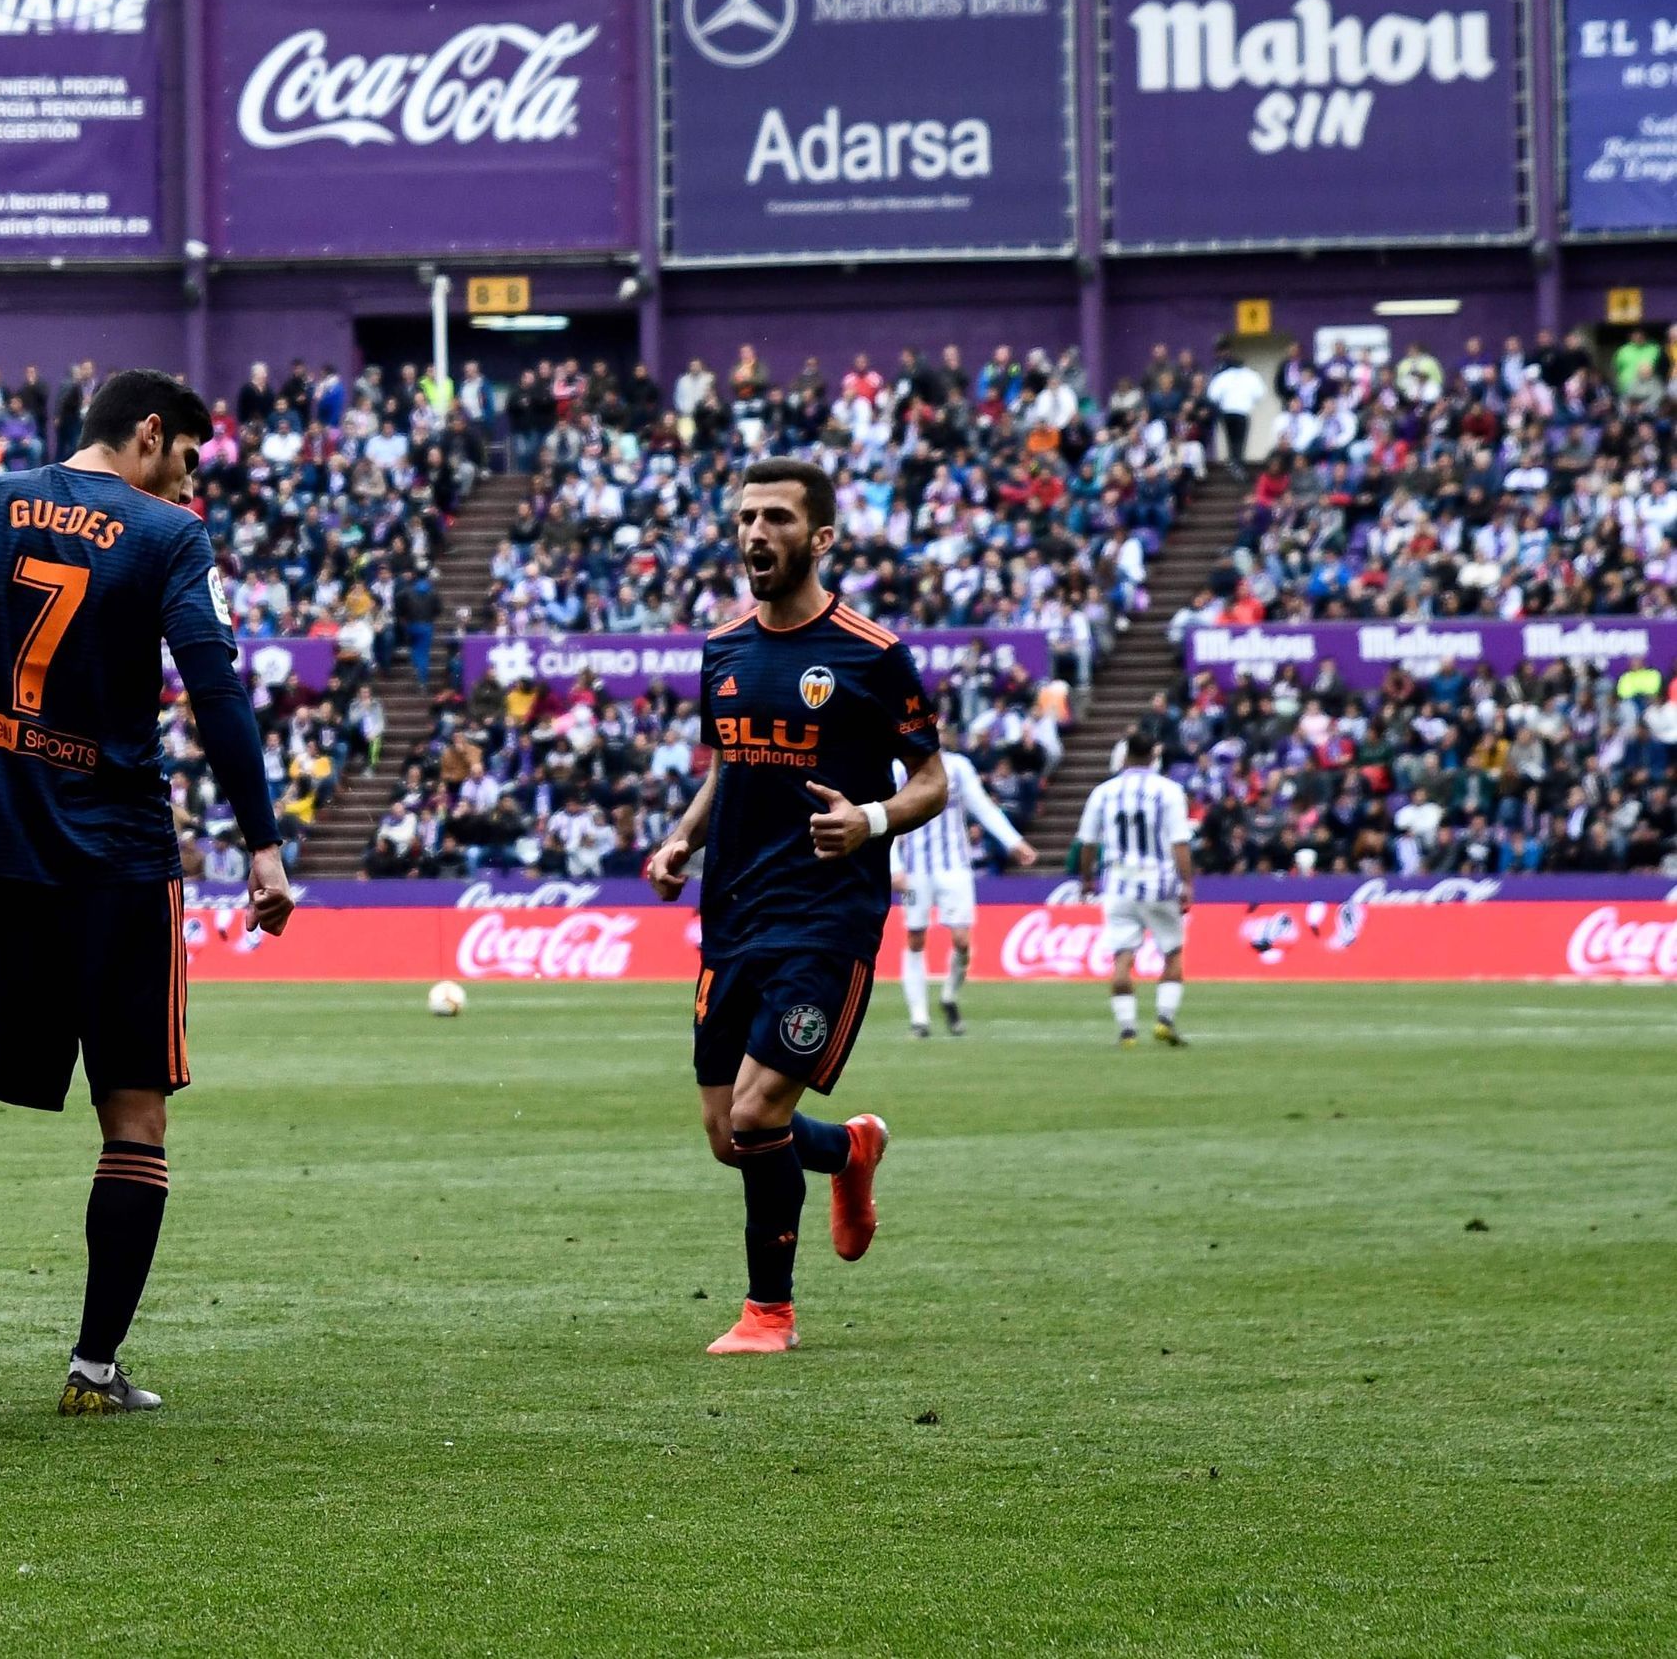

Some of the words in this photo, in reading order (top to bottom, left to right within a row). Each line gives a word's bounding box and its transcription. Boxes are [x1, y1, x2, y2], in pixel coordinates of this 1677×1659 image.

[238, 21, 600, 148] Coca-Cola
[746, 106, 992, 185] Adarsa
[1251, 90, 1375, 154] SIN
[9, 497, 125, 550] GUEDES
[11, 554, 91, 717] 7
[537, 647, 639, 677] CUATRO
[641, 647, 704, 675] RAYA
[24, 729, 98, 767] SPORTS
[715, 717, 820, 750] BLU
[721, 746, 818, 768] martphones
[1114, 809, 1148, 857] 11
[455, 910, 641, 980] Coca-Cola
[784, 1007, 804, 1024] ALFA
[807, 1007, 826, 1037] ROMEO
